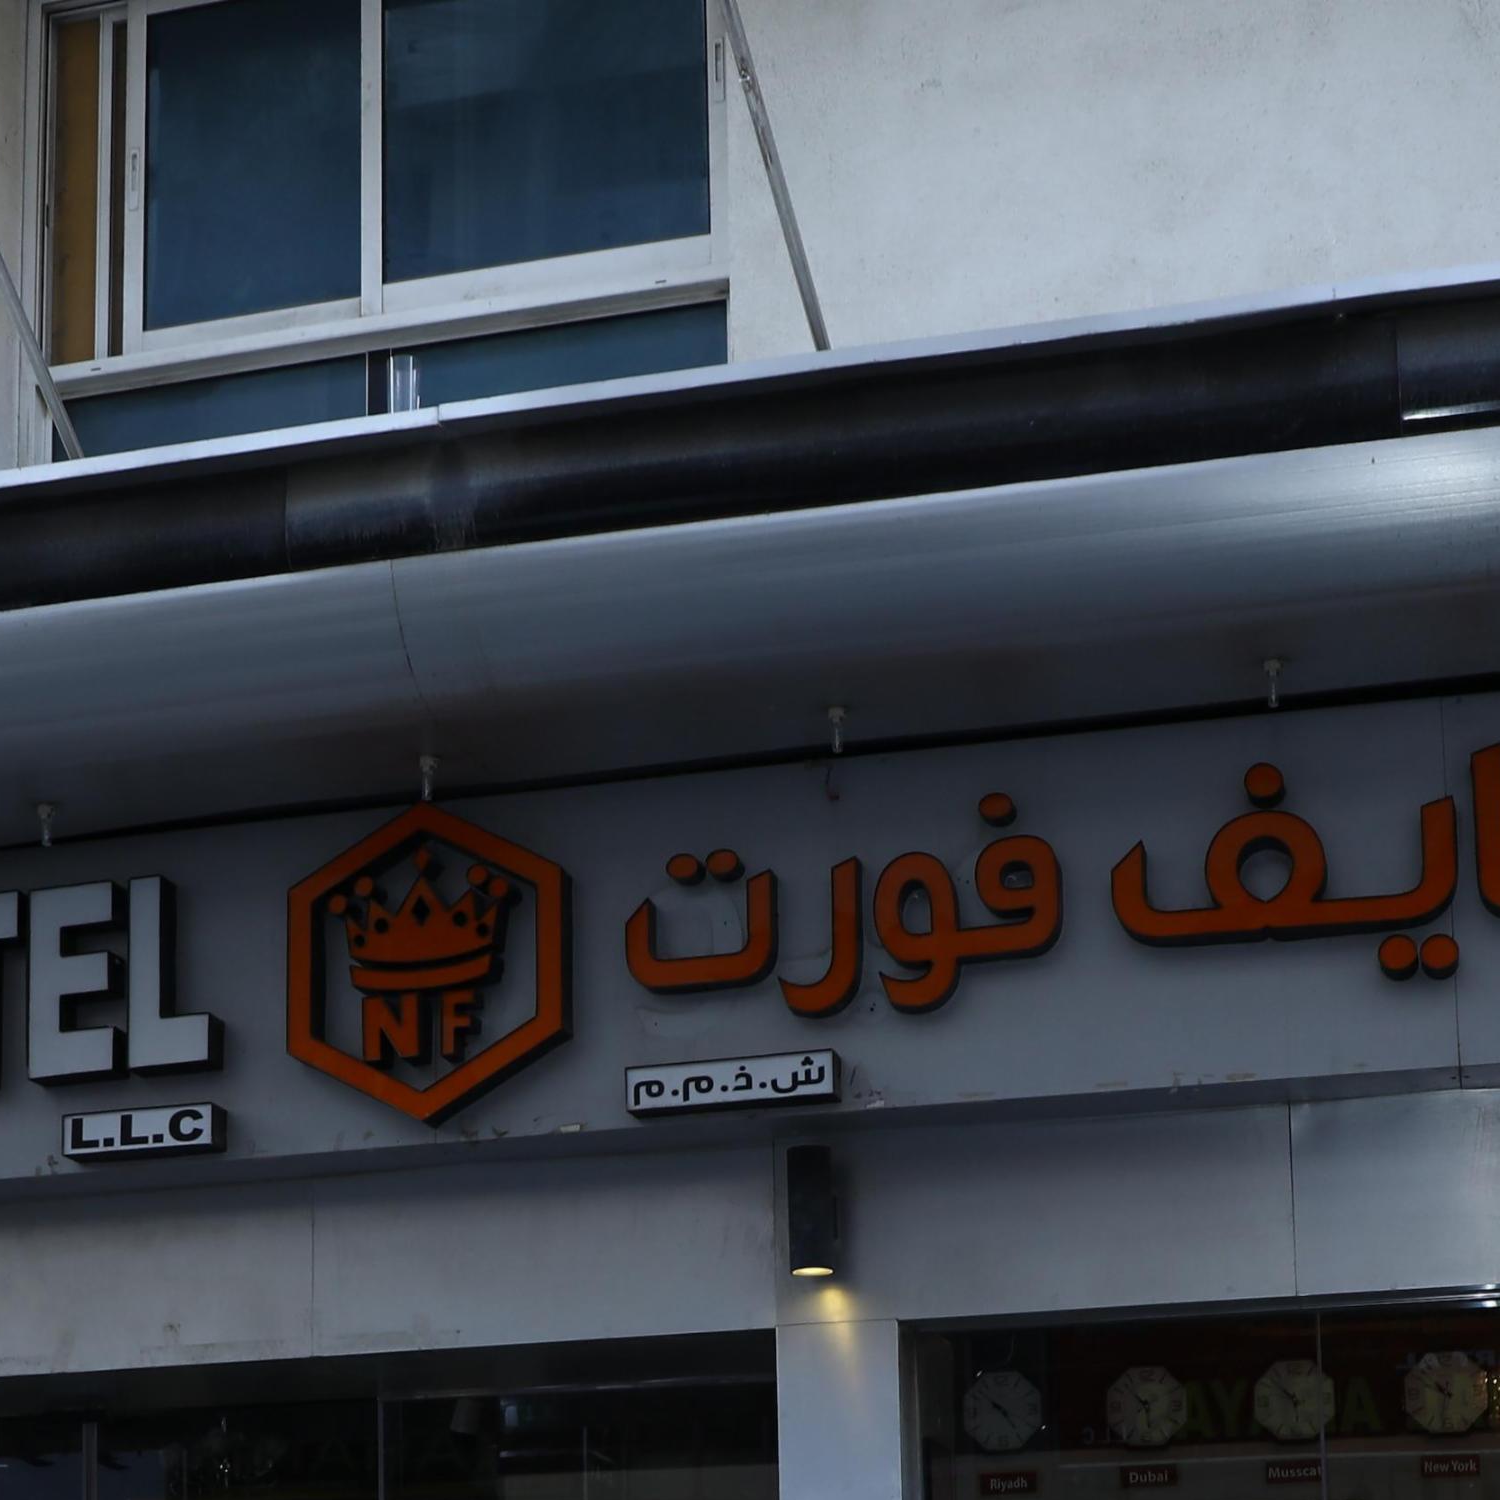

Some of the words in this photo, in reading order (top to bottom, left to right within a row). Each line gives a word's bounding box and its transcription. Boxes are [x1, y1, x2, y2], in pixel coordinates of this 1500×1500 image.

[624, 790, 1064, 1019] فورت
[69, 1108, 210, 1151] L.L.C
[1128, 1468, 1170, 1486] Dubai
[1424, 1460, 1449, 1474] New
[1449, 1460, 1478, 1474] York
